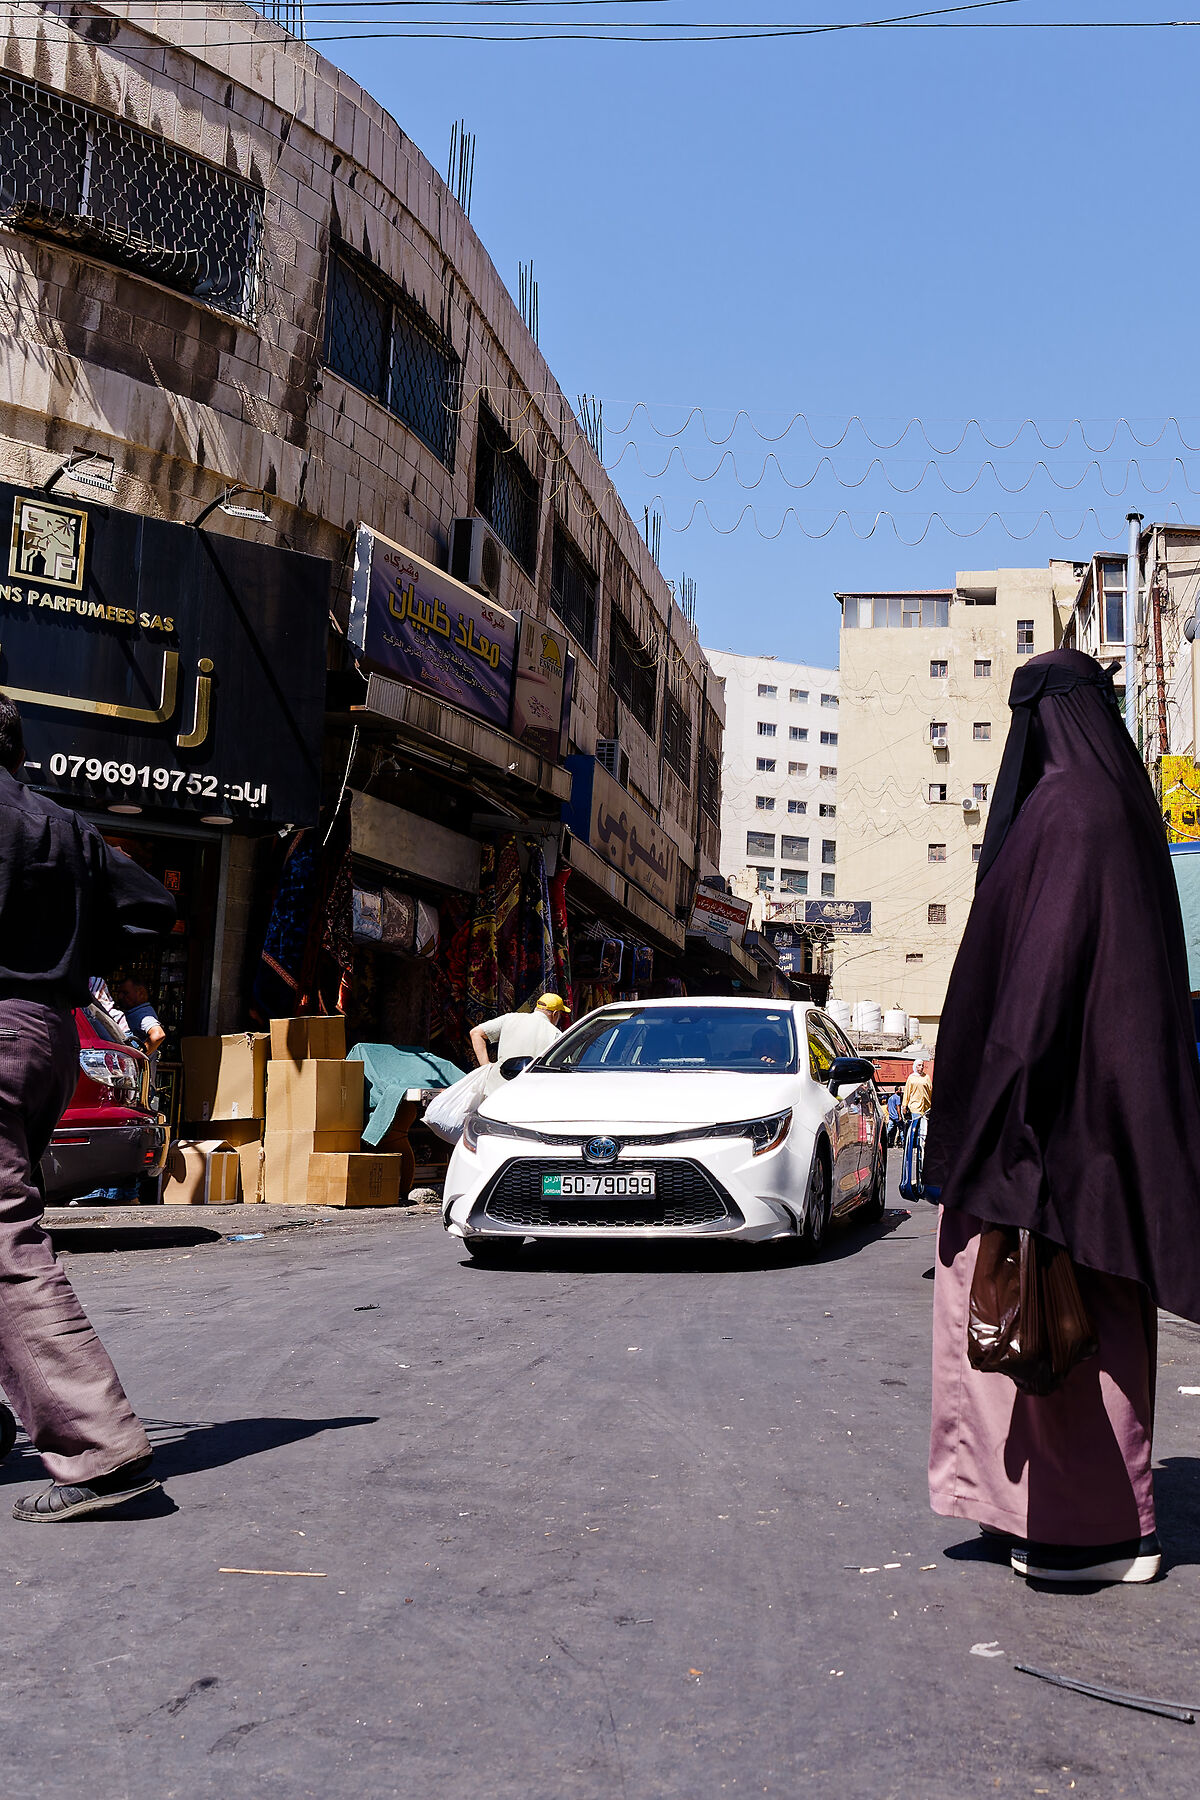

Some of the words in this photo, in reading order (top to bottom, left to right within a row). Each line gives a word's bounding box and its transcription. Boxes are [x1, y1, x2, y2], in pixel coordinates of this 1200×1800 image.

[27, 589, 136, 625] PARFUMEES
[139, 612, 175, 632] SAS
[453, 613, 501, 669] معاذ
[49, 753, 219, 798] 0796919752
[562, 1176, 652, 1194] 50-79099
